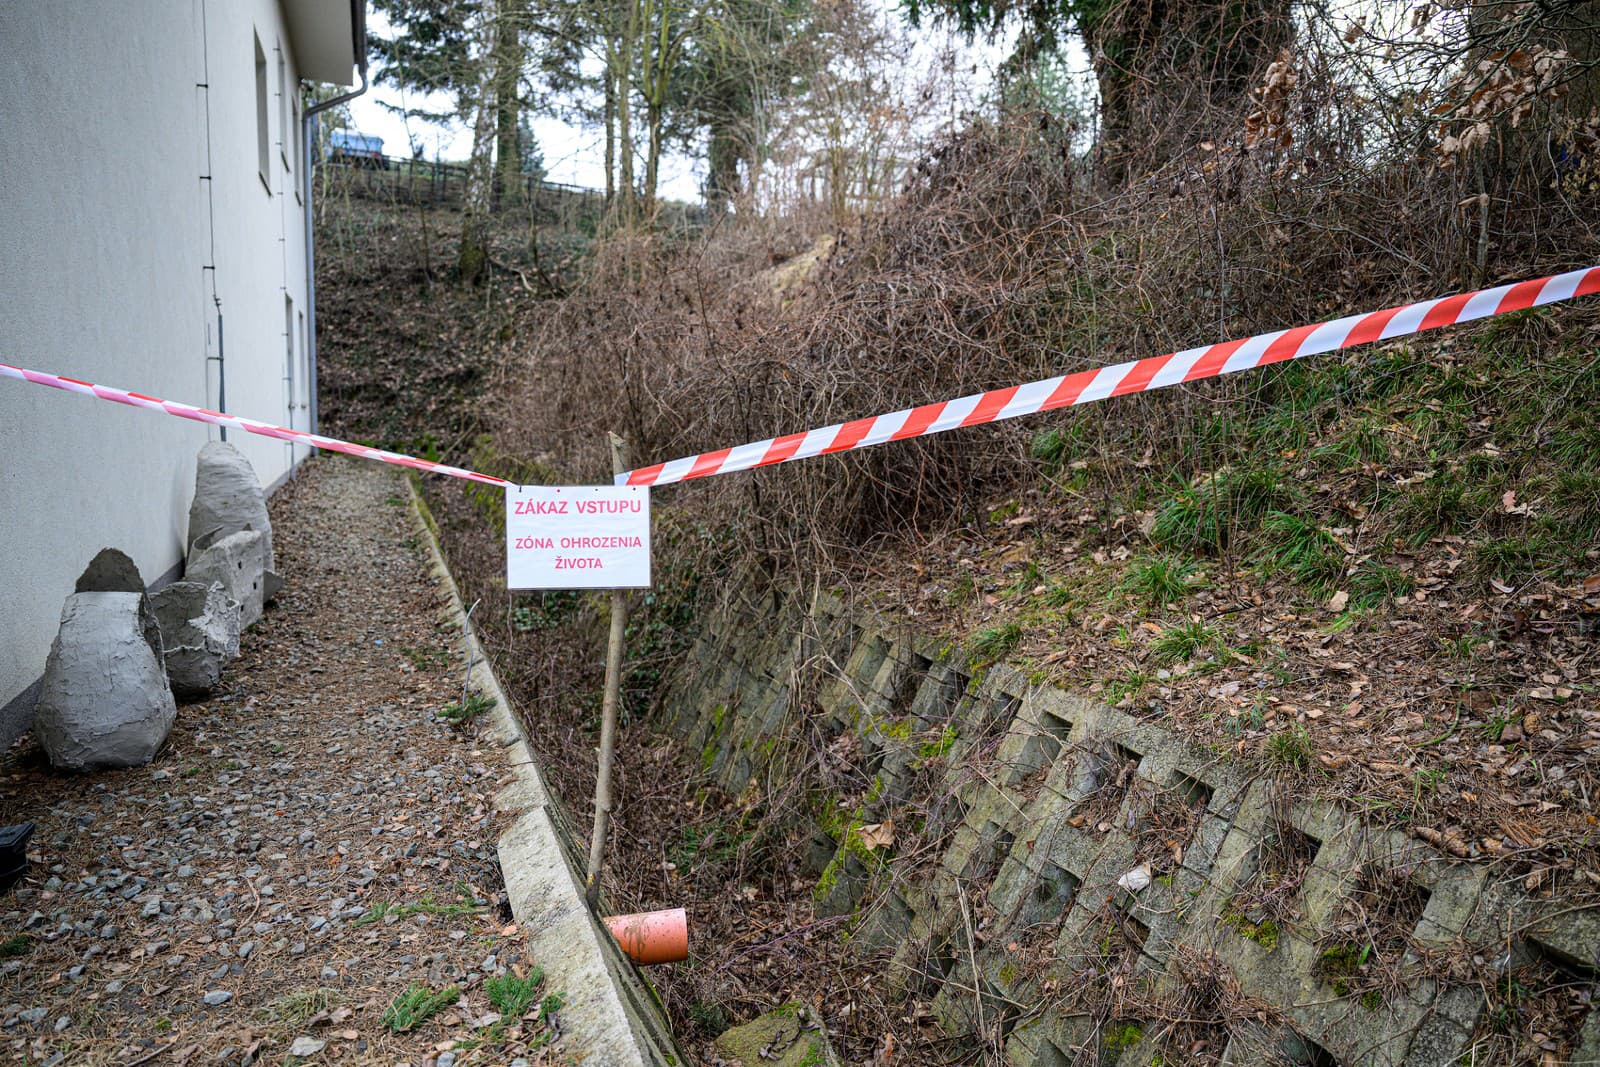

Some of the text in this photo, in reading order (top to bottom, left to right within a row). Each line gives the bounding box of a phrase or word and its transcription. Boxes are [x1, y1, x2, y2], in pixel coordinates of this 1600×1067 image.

[514, 498, 642, 515] ZÁKAZ VSTUPU
[515, 535, 643, 550] ZÓNA OHROZENIA
[554, 555, 603, 570] ŽIVOTA
